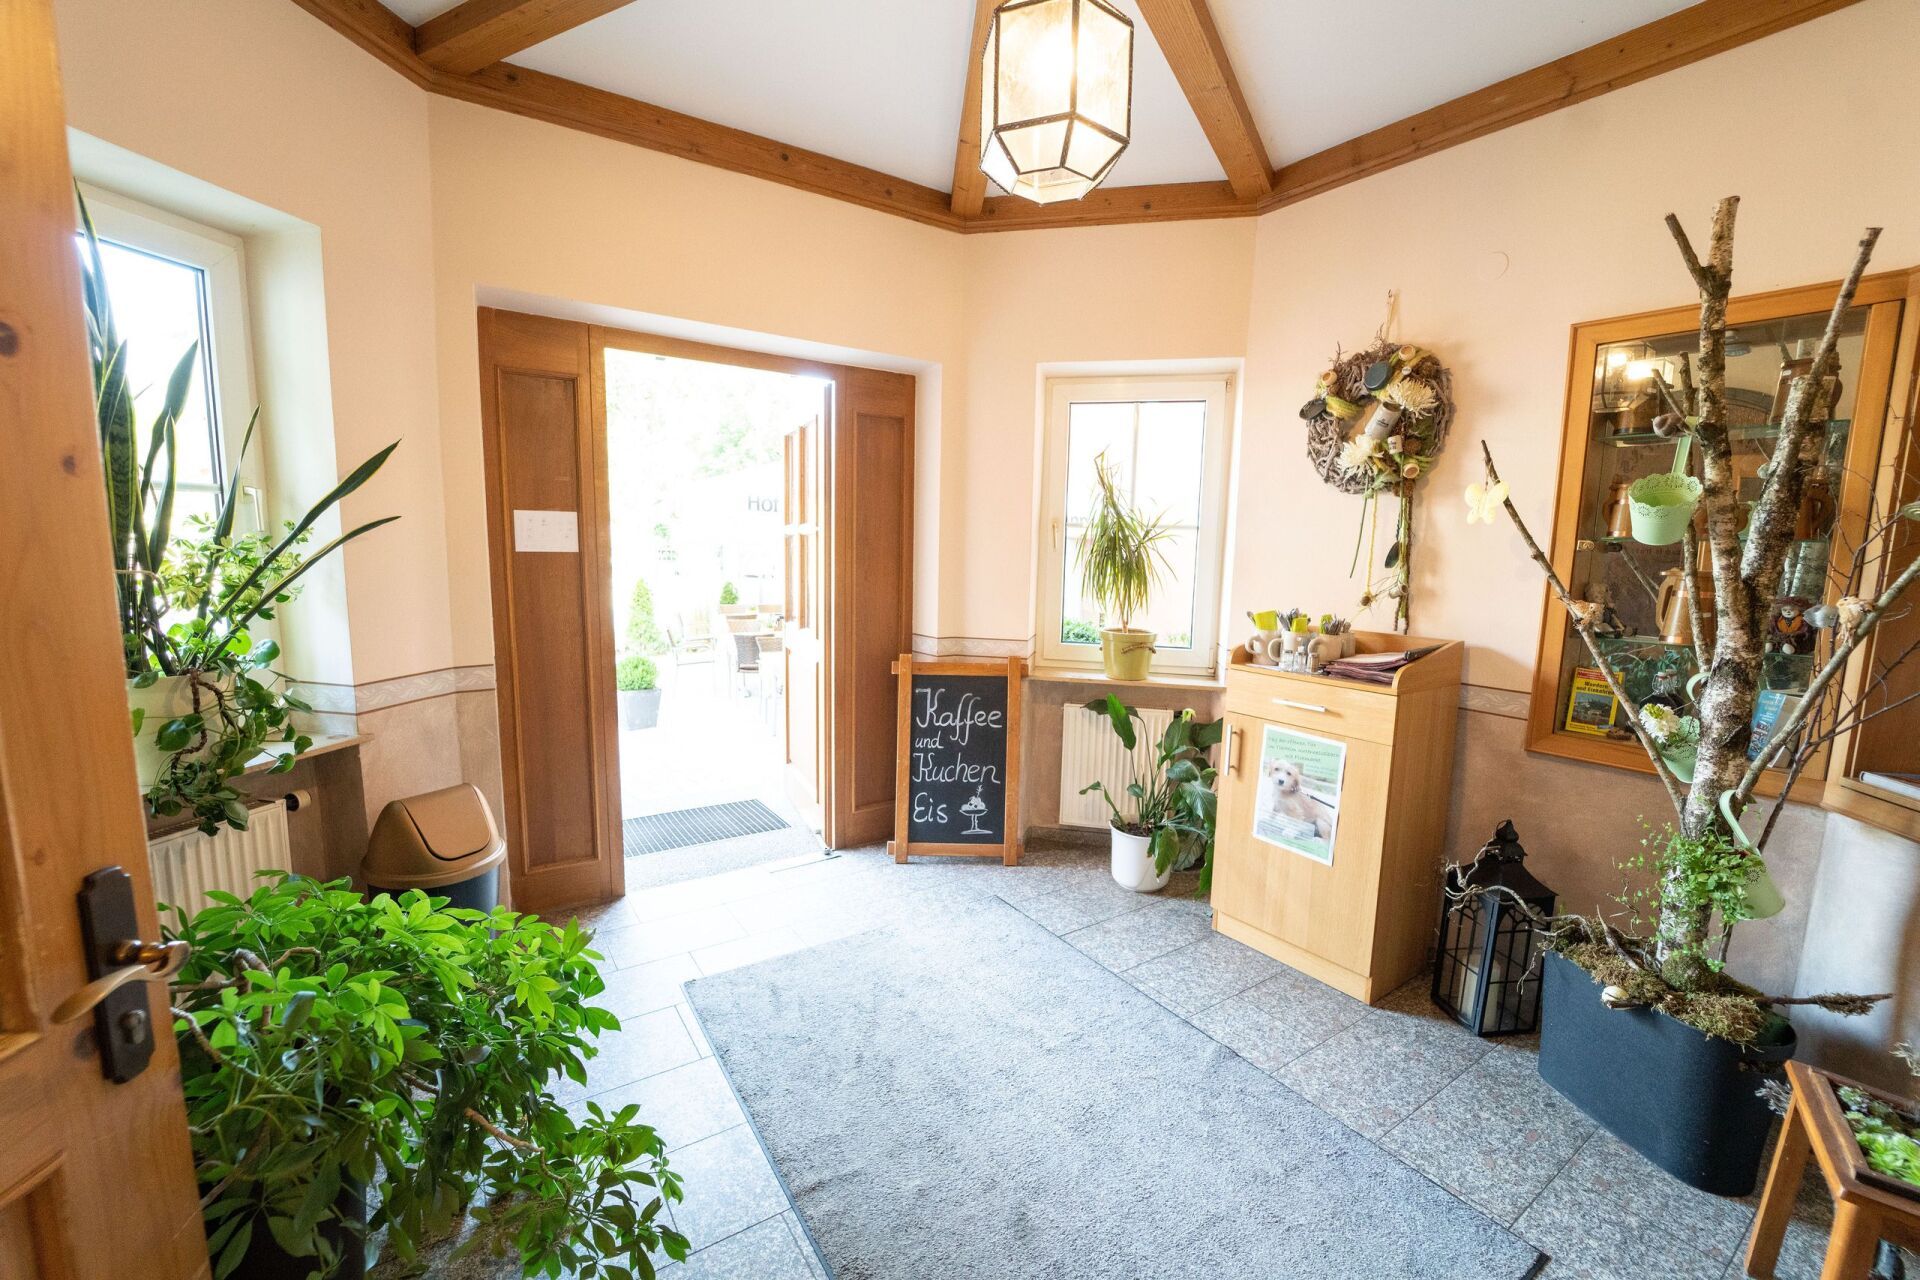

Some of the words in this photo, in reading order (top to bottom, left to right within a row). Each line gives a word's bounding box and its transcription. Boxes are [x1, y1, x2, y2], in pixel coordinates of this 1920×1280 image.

[915, 688, 1002, 745] Kaffee
[915, 731, 944, 749] und
[912, 752, 1000, 784] Kuchen
[913, 792, 948, 823] Eis
